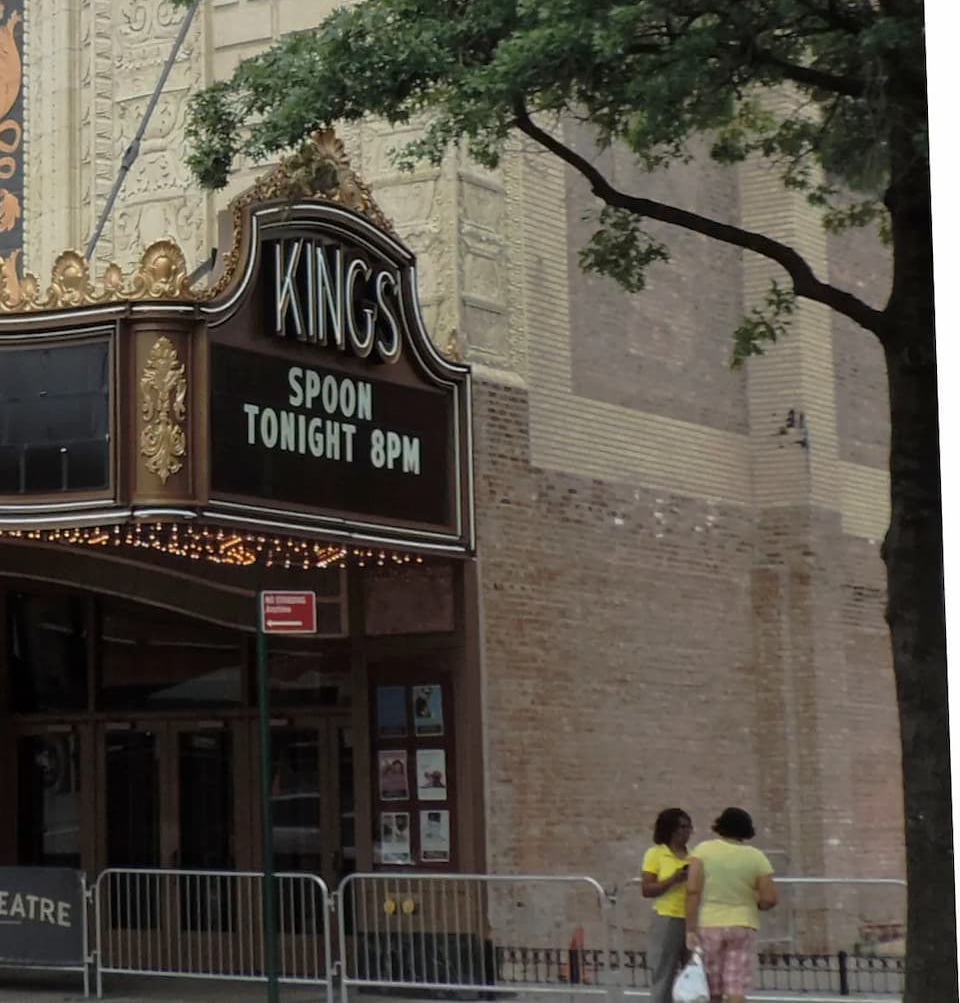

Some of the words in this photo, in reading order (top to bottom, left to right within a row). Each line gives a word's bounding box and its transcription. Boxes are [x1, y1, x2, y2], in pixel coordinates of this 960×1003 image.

[274, 238, 402, 364] KINGS
[288, 366, 373, 421] SPOON
[243, 403, 357, 462] TONIGHT
[370, 429, 421, 475] 8PM
